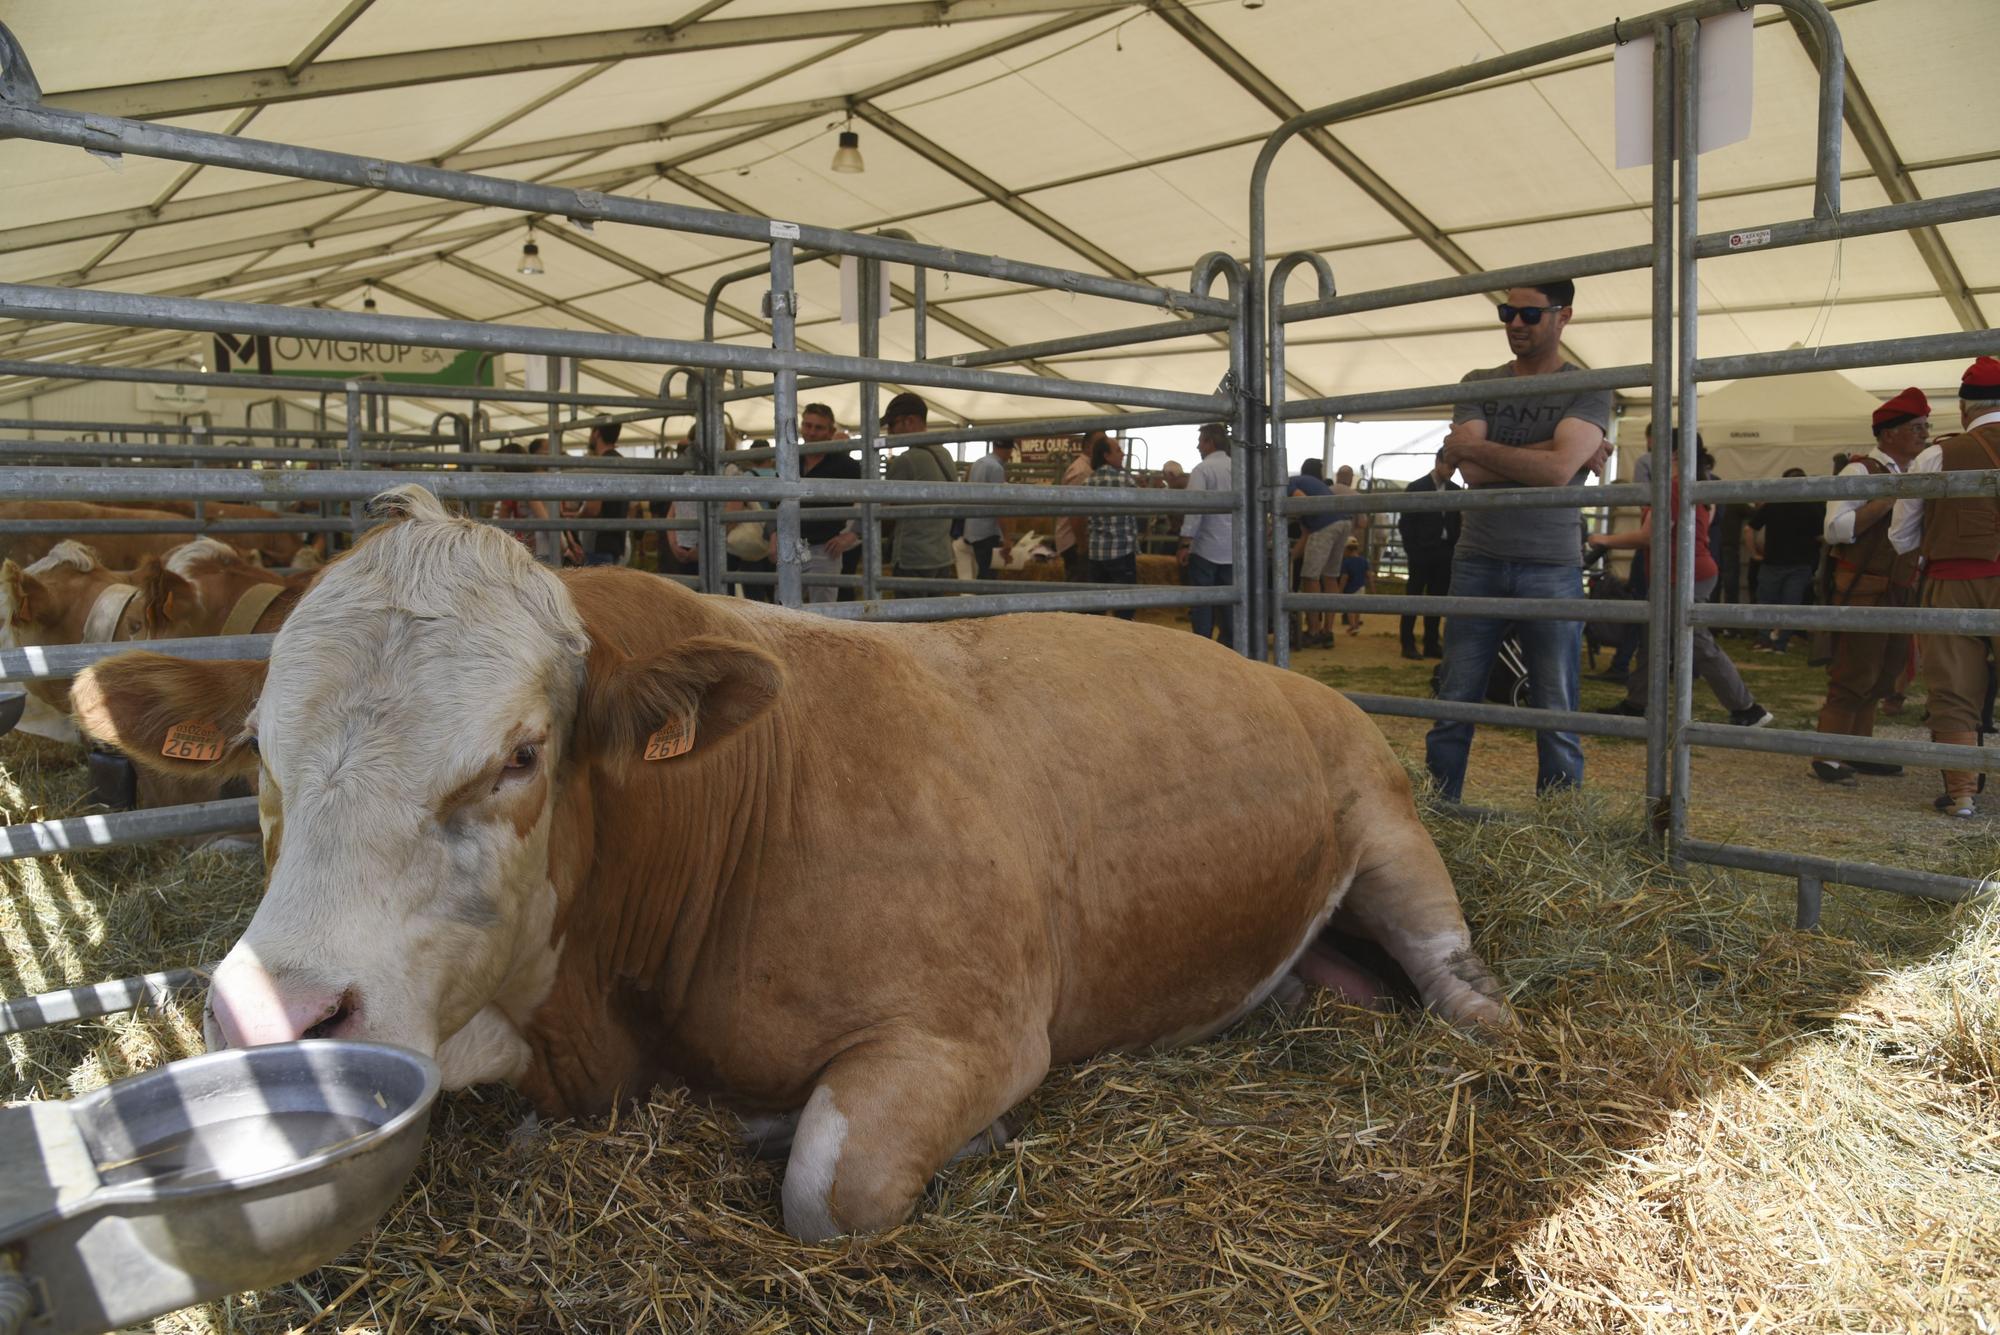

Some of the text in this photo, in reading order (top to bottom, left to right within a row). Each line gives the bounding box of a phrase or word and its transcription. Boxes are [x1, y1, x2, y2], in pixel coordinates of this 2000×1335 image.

[213, 332, 444, 374] MOVIGRUP SA
[164, 738, 216, 758] 2611
